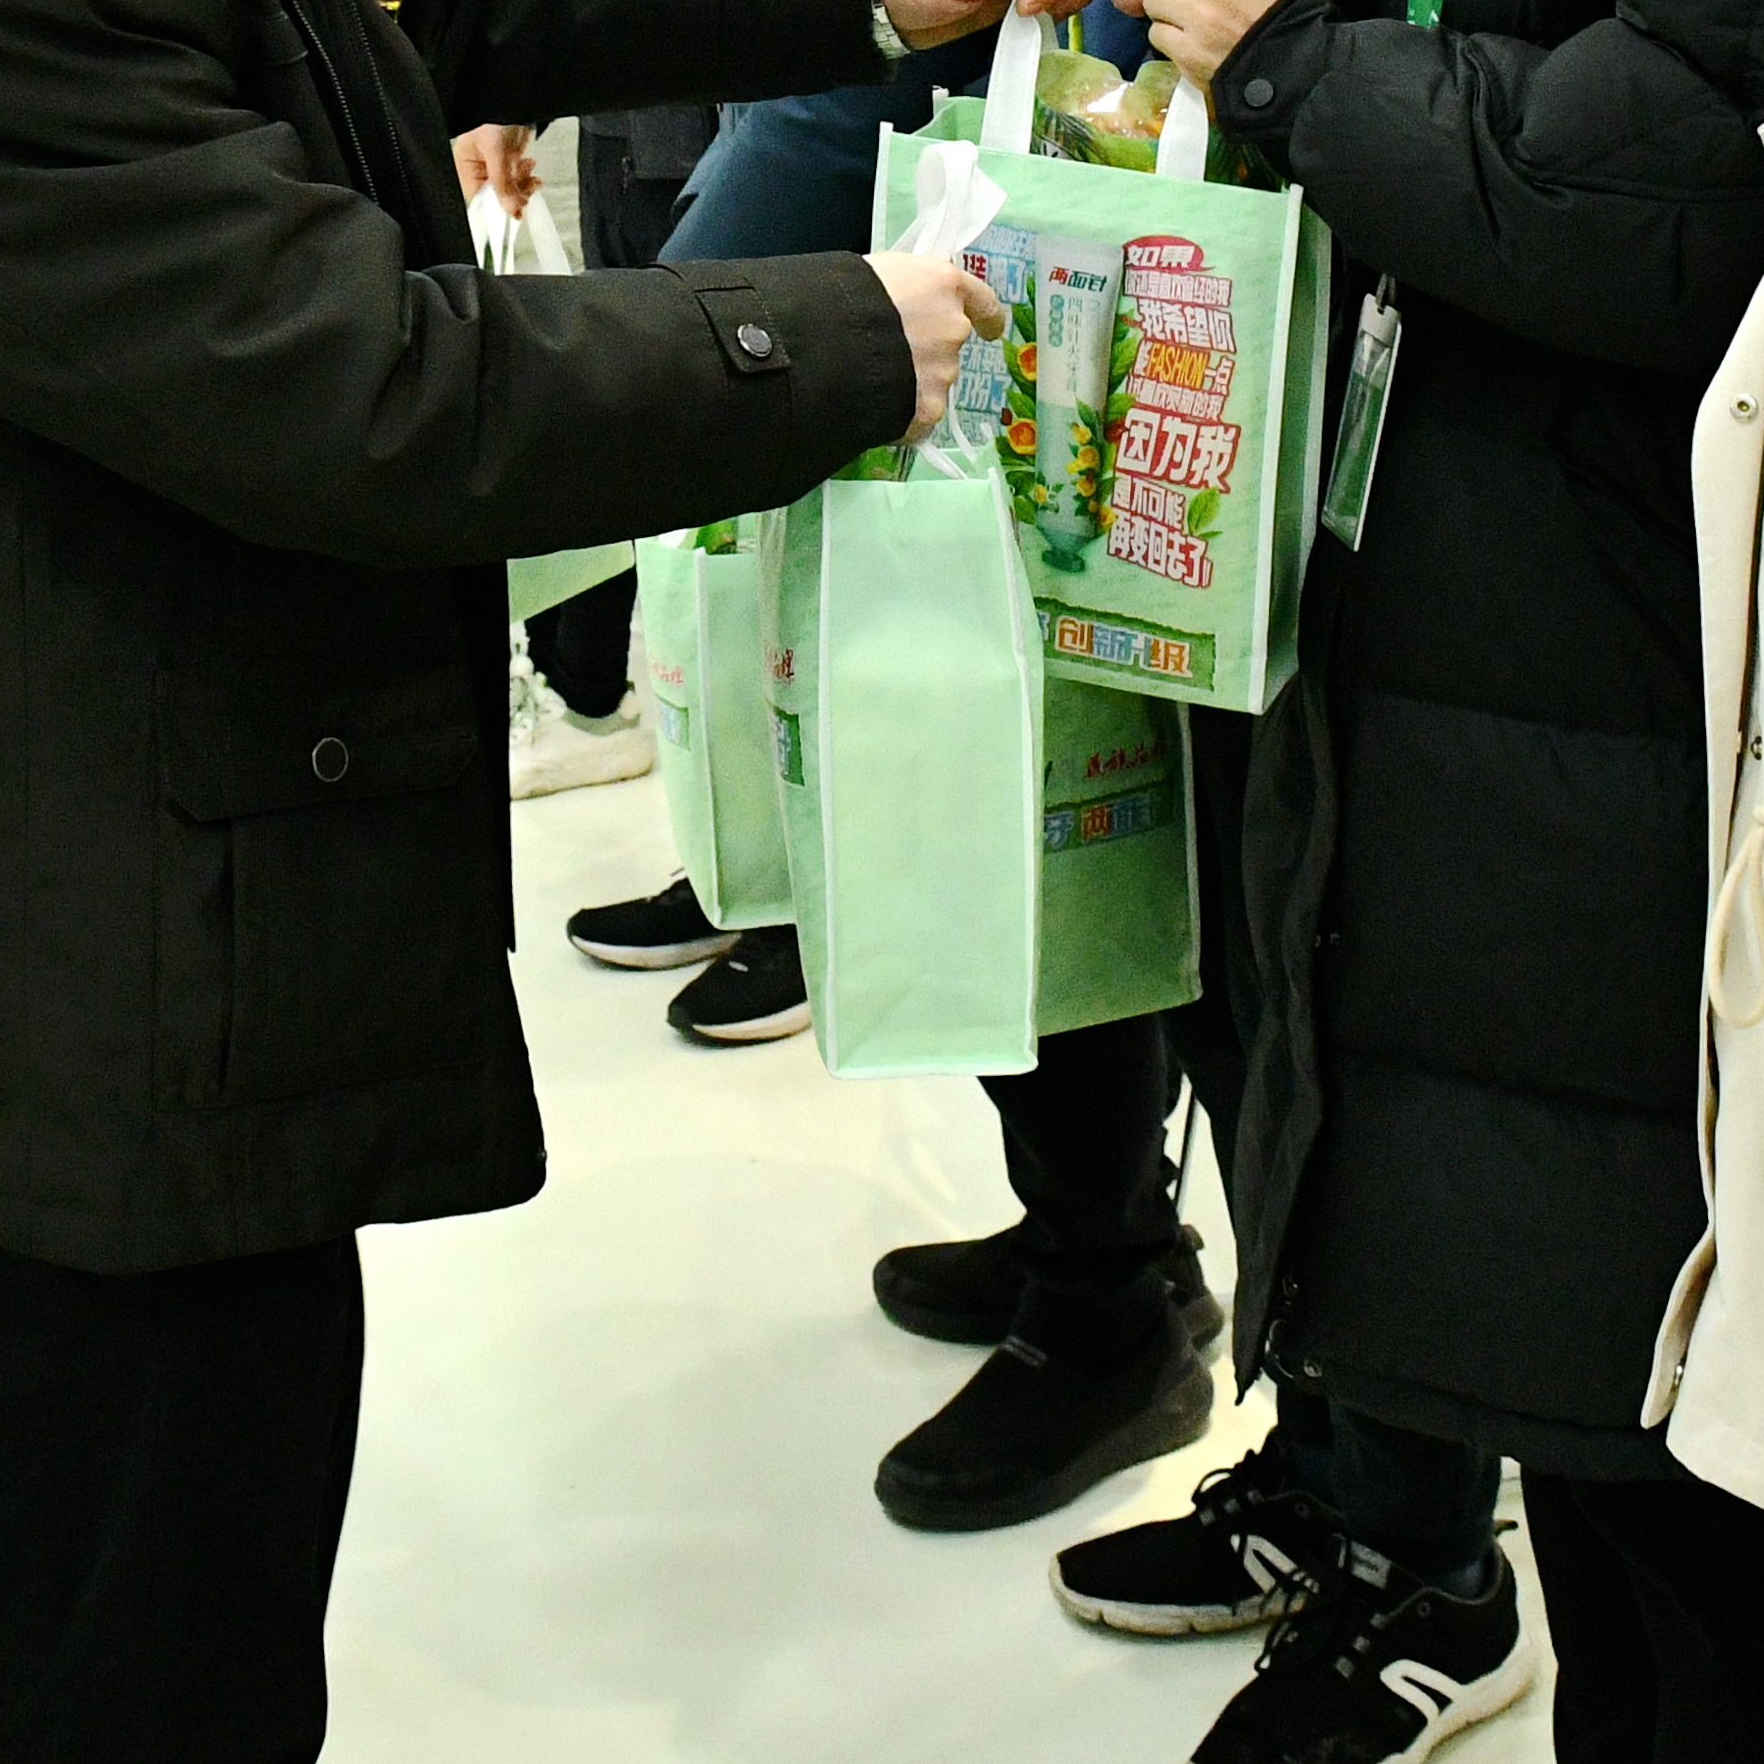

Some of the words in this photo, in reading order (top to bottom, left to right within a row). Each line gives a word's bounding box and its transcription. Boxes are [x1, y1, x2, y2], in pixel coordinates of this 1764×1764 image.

[1048, 265, 1108, 293] 两面针
[1126, 245, 1194, 268] 如果
[1138, 299, 1236, 353] 我希望你
[1115, 408, 1237, 491] 因为我
[1113, 471, 1185, 529] 是不可能
[1055, 616, 1193, 679] 创新升级
